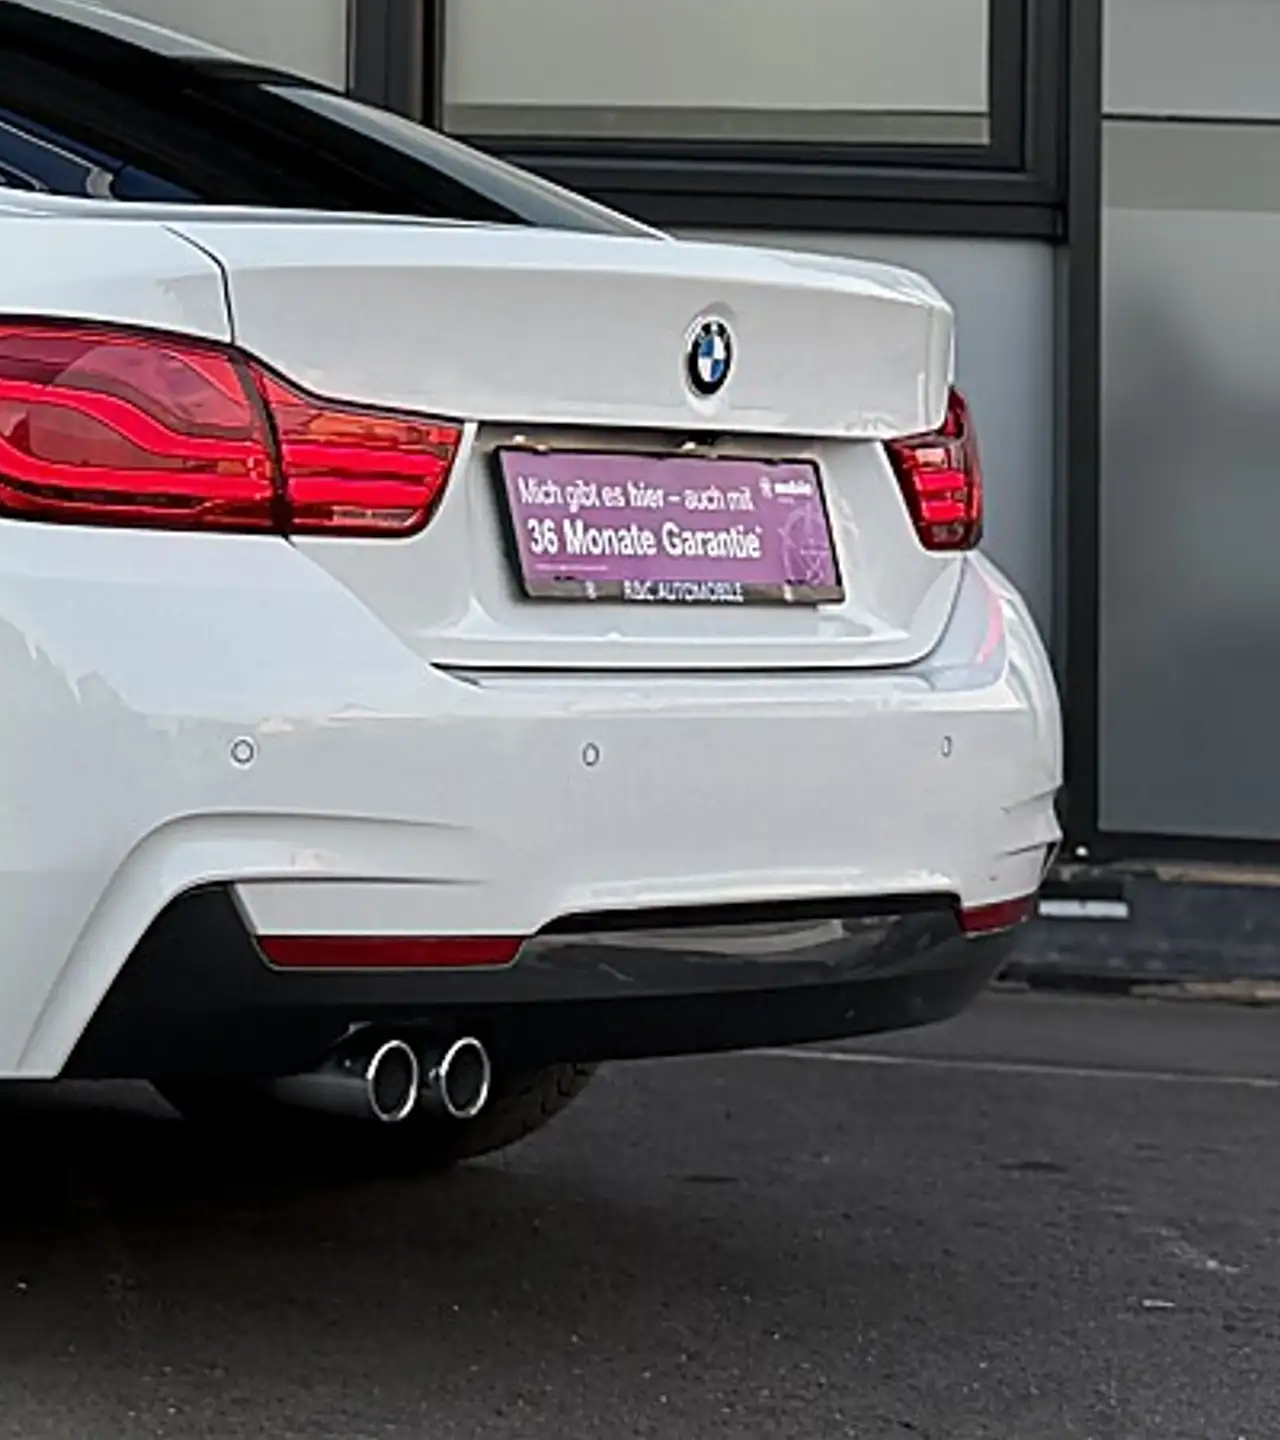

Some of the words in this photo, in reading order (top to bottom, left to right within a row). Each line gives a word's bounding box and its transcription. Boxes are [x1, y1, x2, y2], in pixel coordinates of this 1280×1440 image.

[517, 476, 563, 505] Mich
[565, 479, 600, 513] gibt
[601, 486, 625, 507] es
[627, 479, 665, 509] hier
[683, 484, 725, 511] auch
[726, 486, 755, 512] mit
[527, 518, 558, 555] 36
[562, 518, 658, 556] Monate
[658, 580, 744, 603] AUTOMOBILE
